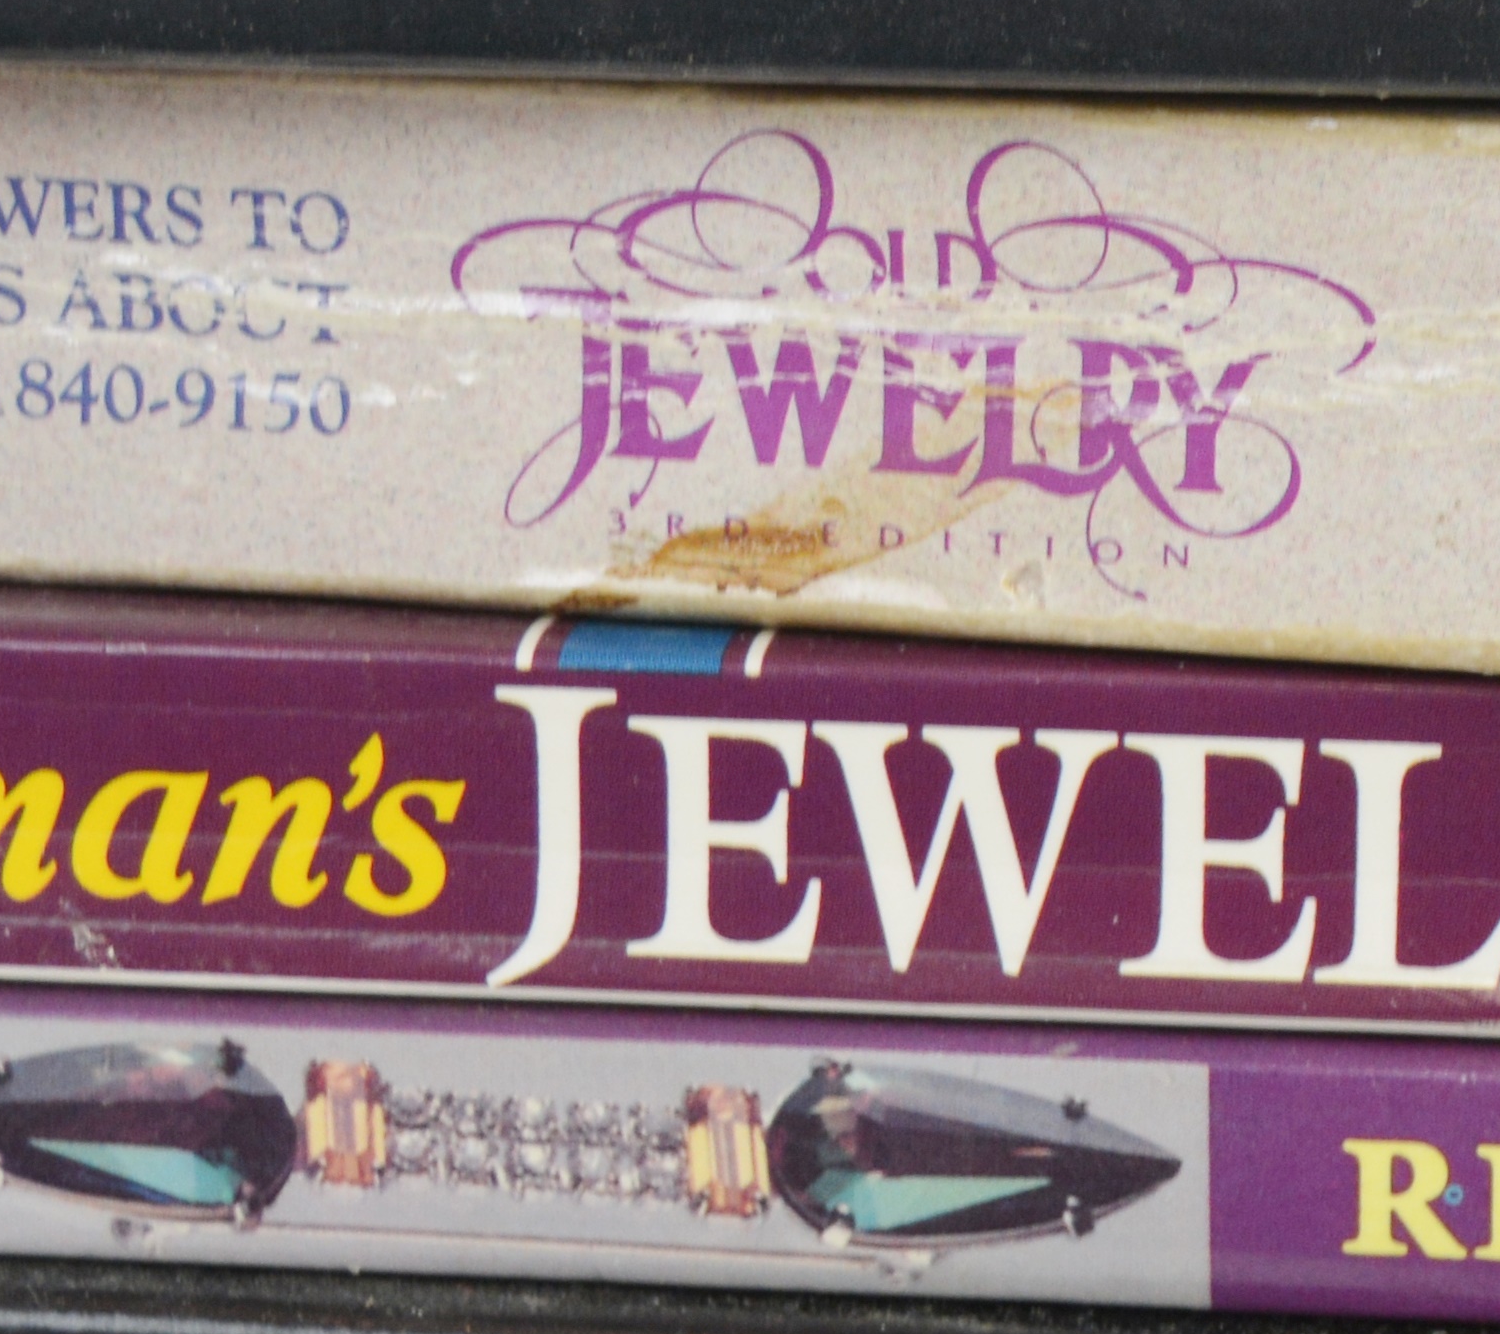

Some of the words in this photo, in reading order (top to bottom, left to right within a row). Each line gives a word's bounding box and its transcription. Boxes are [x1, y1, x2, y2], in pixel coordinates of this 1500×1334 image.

[231, 188, 352, 257] TO
[58, 269, 351, 345] ABOUT
[505, 287, 1302, 539] JEWELRY
